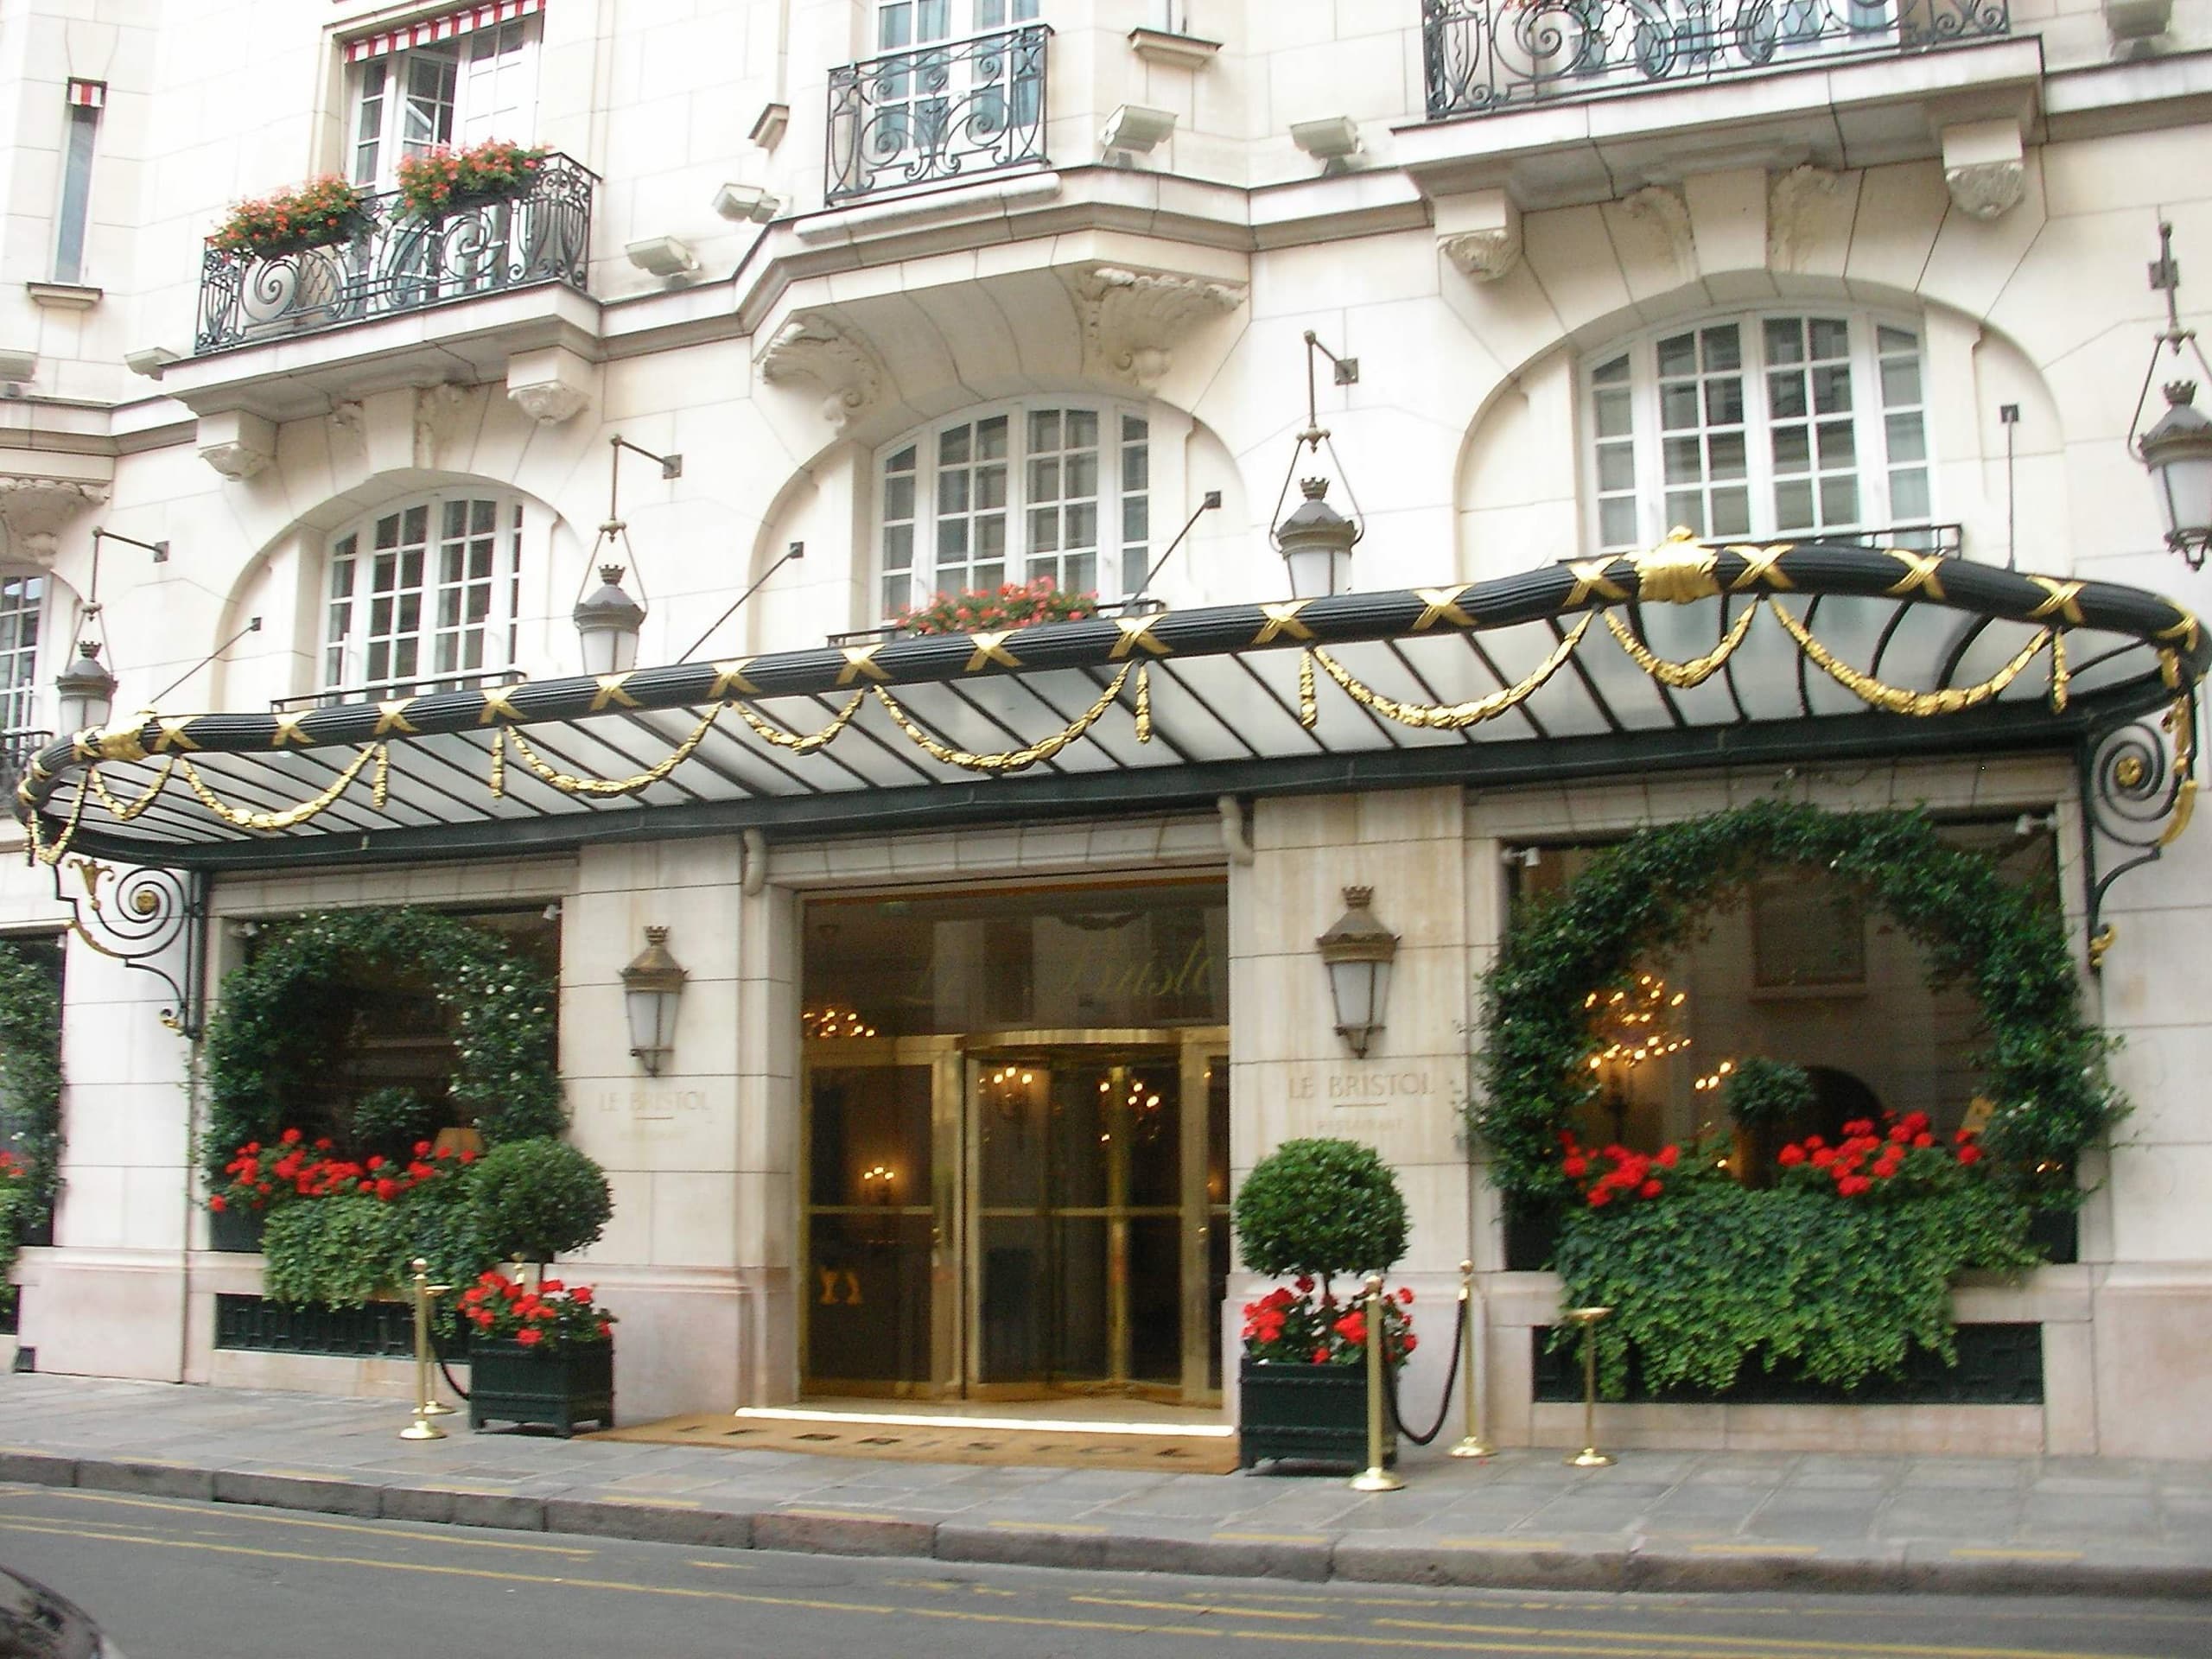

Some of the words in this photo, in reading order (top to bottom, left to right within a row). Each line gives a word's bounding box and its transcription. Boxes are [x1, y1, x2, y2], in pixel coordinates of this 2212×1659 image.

[1287, 1077, 1314, 1100] LE
[1329, 1071, 1435, 1098] BRISTOL
[601, 1091, 620, 1112] LE
[630, 1090, 712, 1111] BRISTOL
